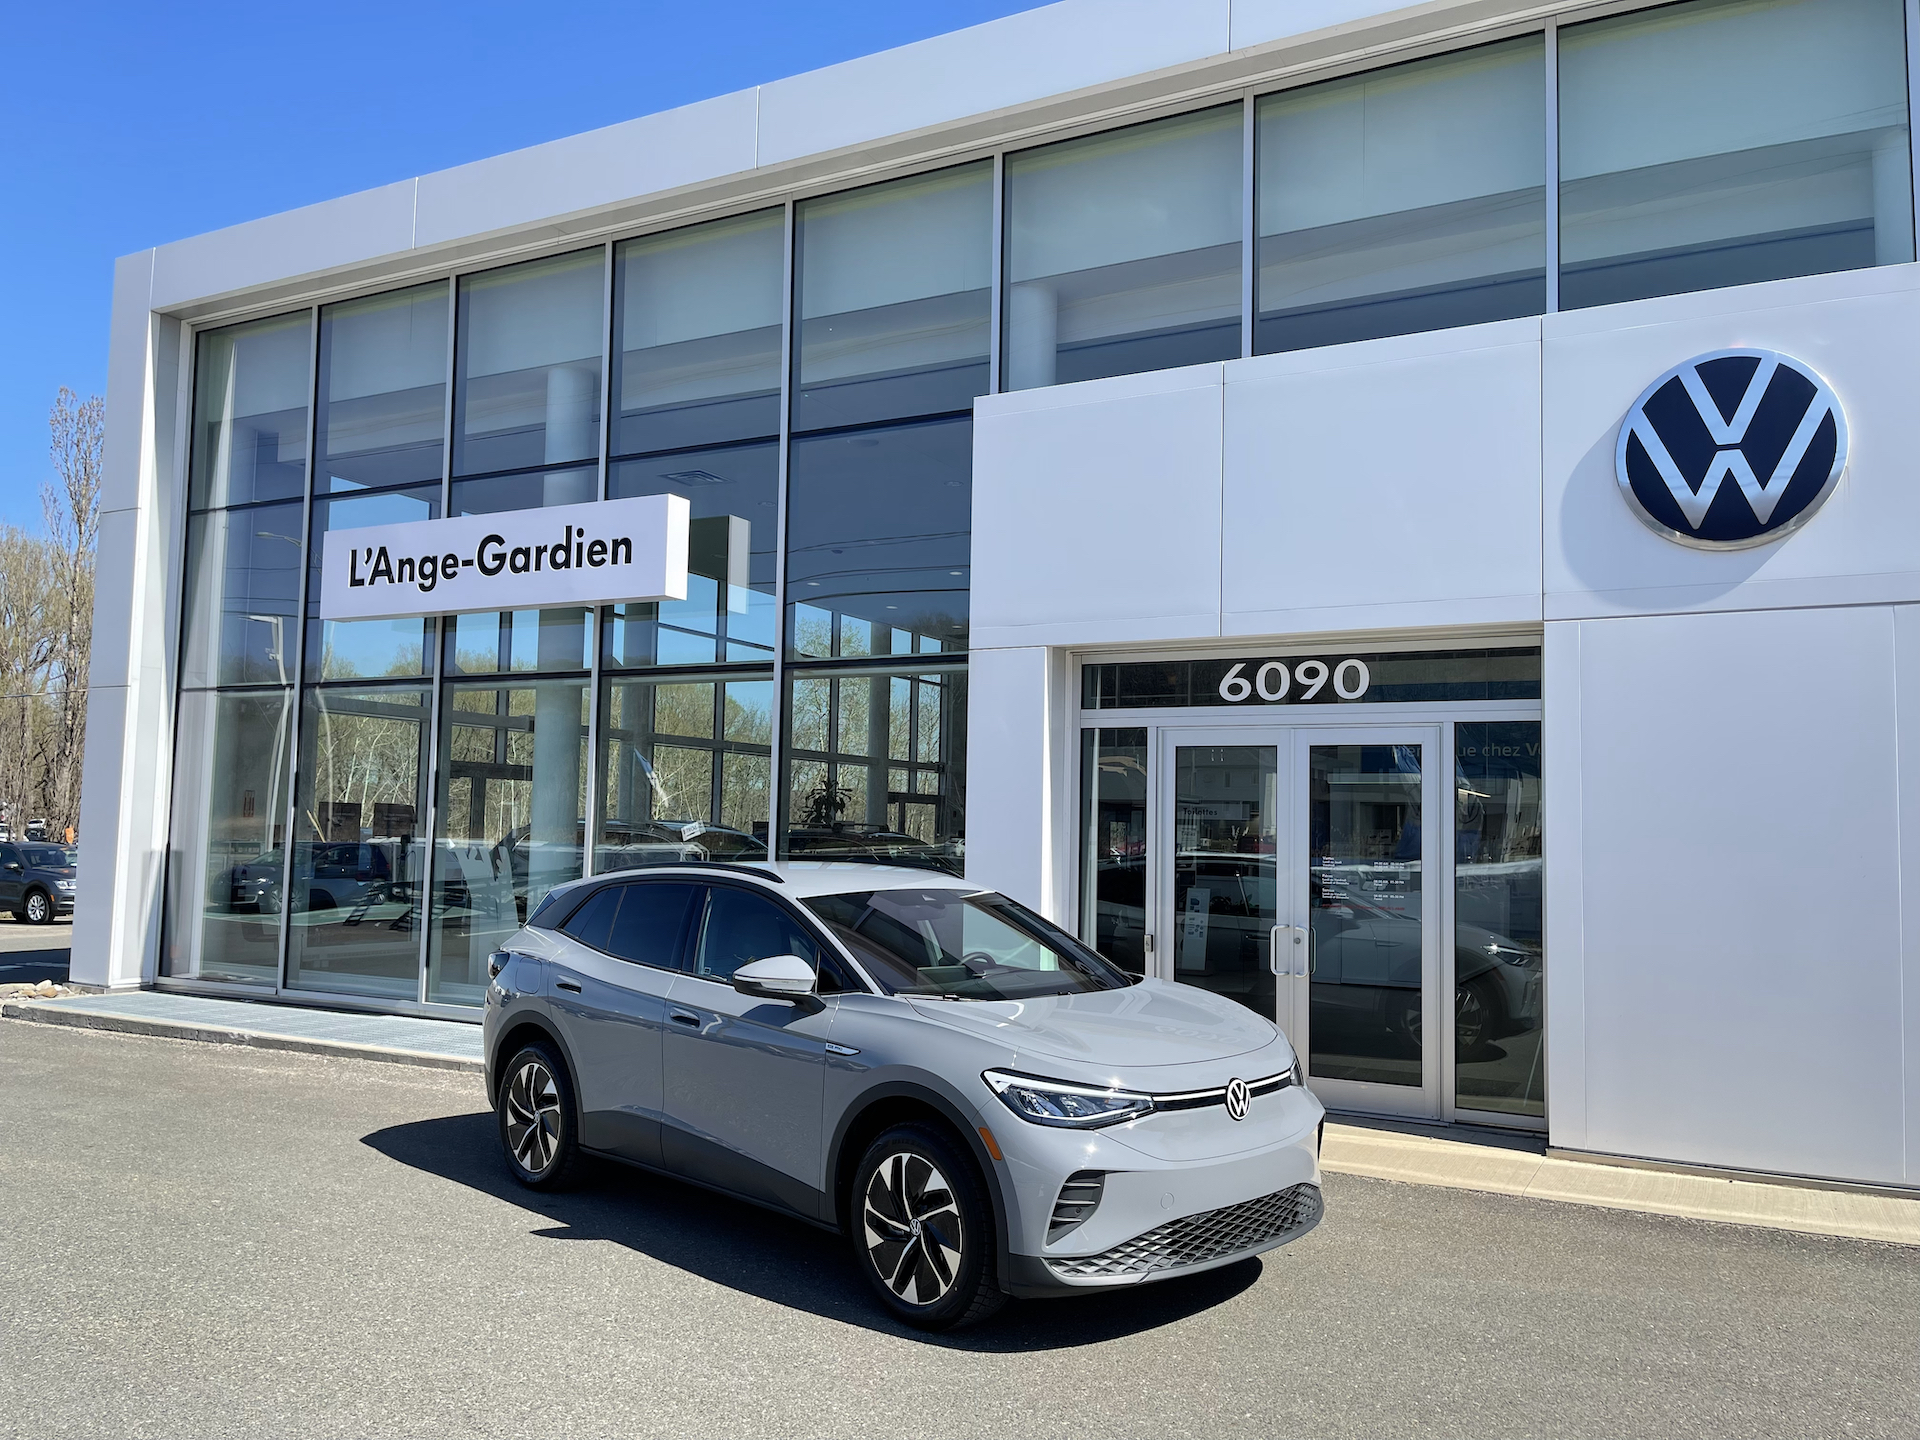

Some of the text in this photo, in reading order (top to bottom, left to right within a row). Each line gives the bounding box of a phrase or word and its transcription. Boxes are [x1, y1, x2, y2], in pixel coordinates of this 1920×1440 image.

[348, 525, 633, 593] L'Ange-Gardien
[1218, 658, 1370, 702] 6090
[1482, 742, 1521, 757] chez
